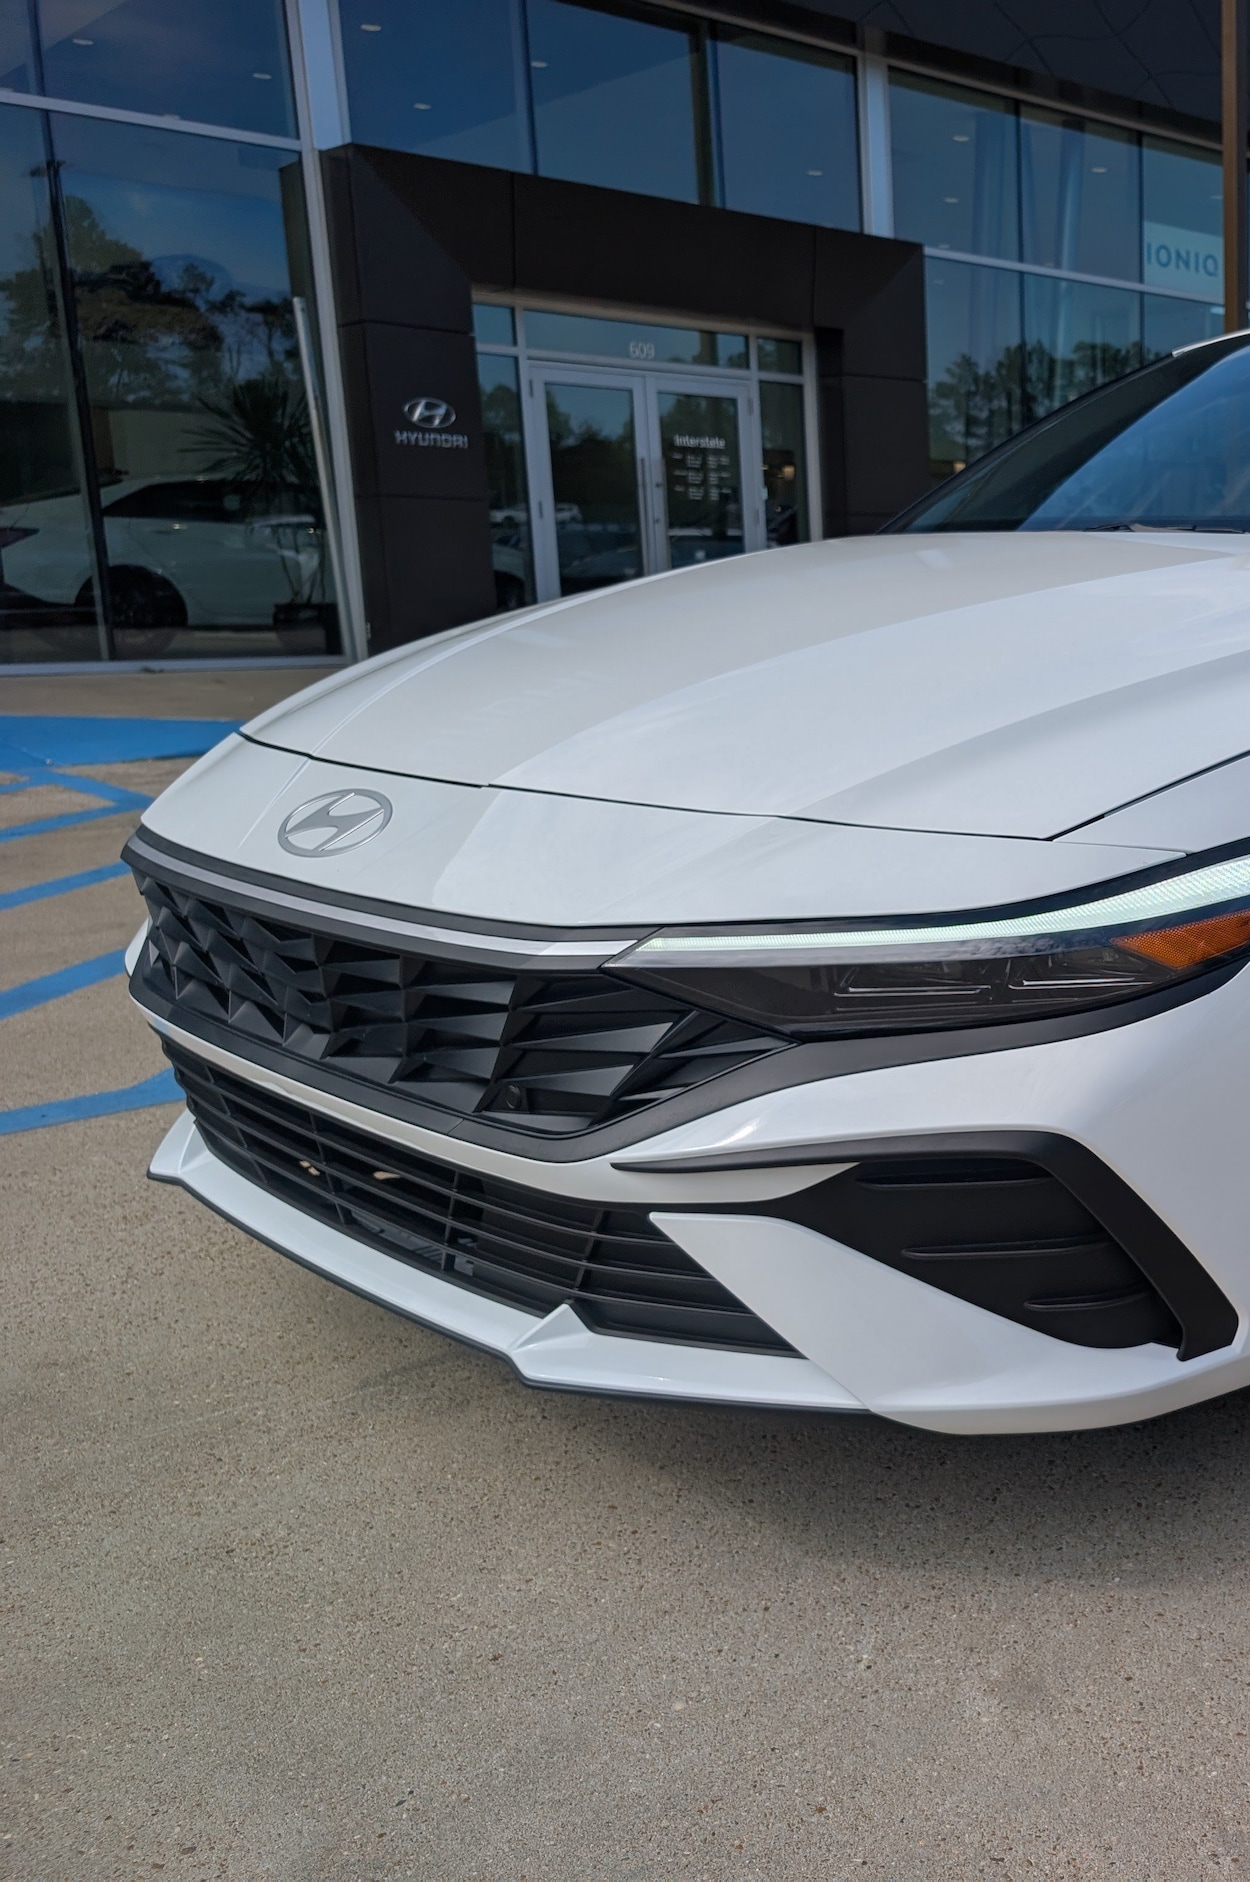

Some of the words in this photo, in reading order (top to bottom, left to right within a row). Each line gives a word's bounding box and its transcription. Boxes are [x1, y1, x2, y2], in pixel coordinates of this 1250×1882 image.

[1146, 242, 1219, 278] IONIQ
[630, 341, 655, 359] 609
[394, 429, 469, 449] HYUNDAI
[673, 433, 726, 450] Interstate
